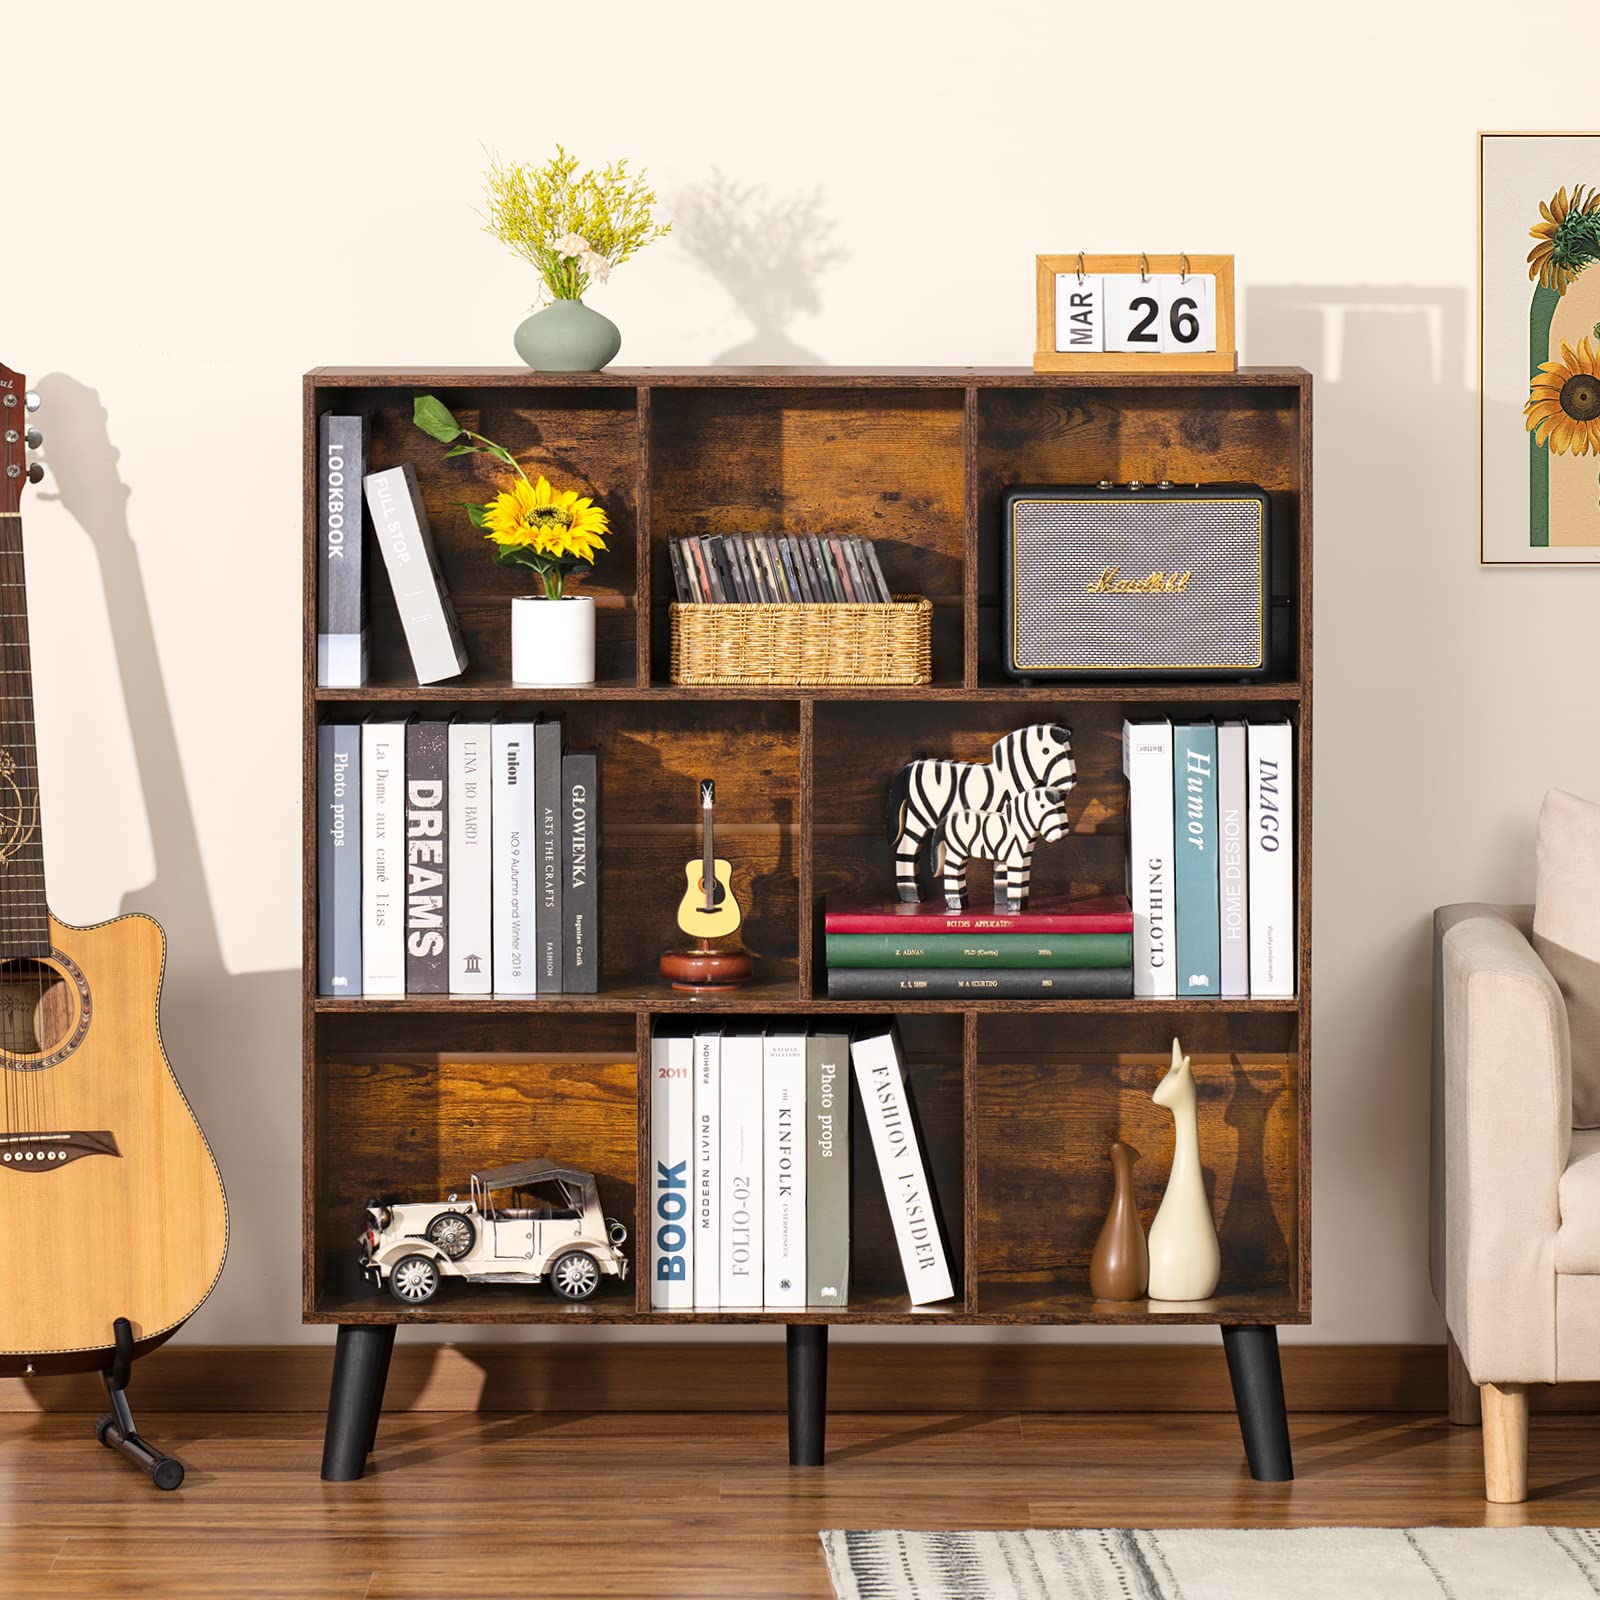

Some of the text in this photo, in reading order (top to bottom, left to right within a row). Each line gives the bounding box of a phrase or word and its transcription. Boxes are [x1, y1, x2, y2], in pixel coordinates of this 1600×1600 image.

[1069, 292, 1093, 345] MAR
[328, 444, 344, 559] LOOKBOOK
[374, 477, 396, 520] FULL
[375, 743, 390, 761] La
[375, 769, 390, 805] Dame
[464, 742, 478, 845] LINA BO BARDI
[507, 742, 520, 786] Union
[1139, 745, 1163, 753] Better
[330, 752, 348, 847] Photo props
[376, 812, 386, 839] aux
[1186, 747, 1211, 851] Humor
[1259, 757, 1280, 853] IMAGO
[408, 779, 445, 957] DREAMS
[510, 831, 522, 977] NO.9 Autumn and Winter 2018
[544, 807, 555, 908] ARTS THE CRAFTS
[376, 894, 390, 927] lias
[576, 944, 584, 967] Guzik
[1149, 858, 1164, 968] CLOTHING
[1225, 883, 1242, 940] HOME
[546, 942, 554, 977] FASHION
[658, 1066, 689, 1080] 2011
[817, 1063, 836, 1158] Photo props
[872, 1065, 910, 1159] FASHION
[701, 1114, 710, 1229] MODERN LIVING
[778, 1108, 792, 1197] KINFOLK
[657, 1160, 687, 1281] BOOK
[732, 1176, 750, 1276] FOLIO-02
